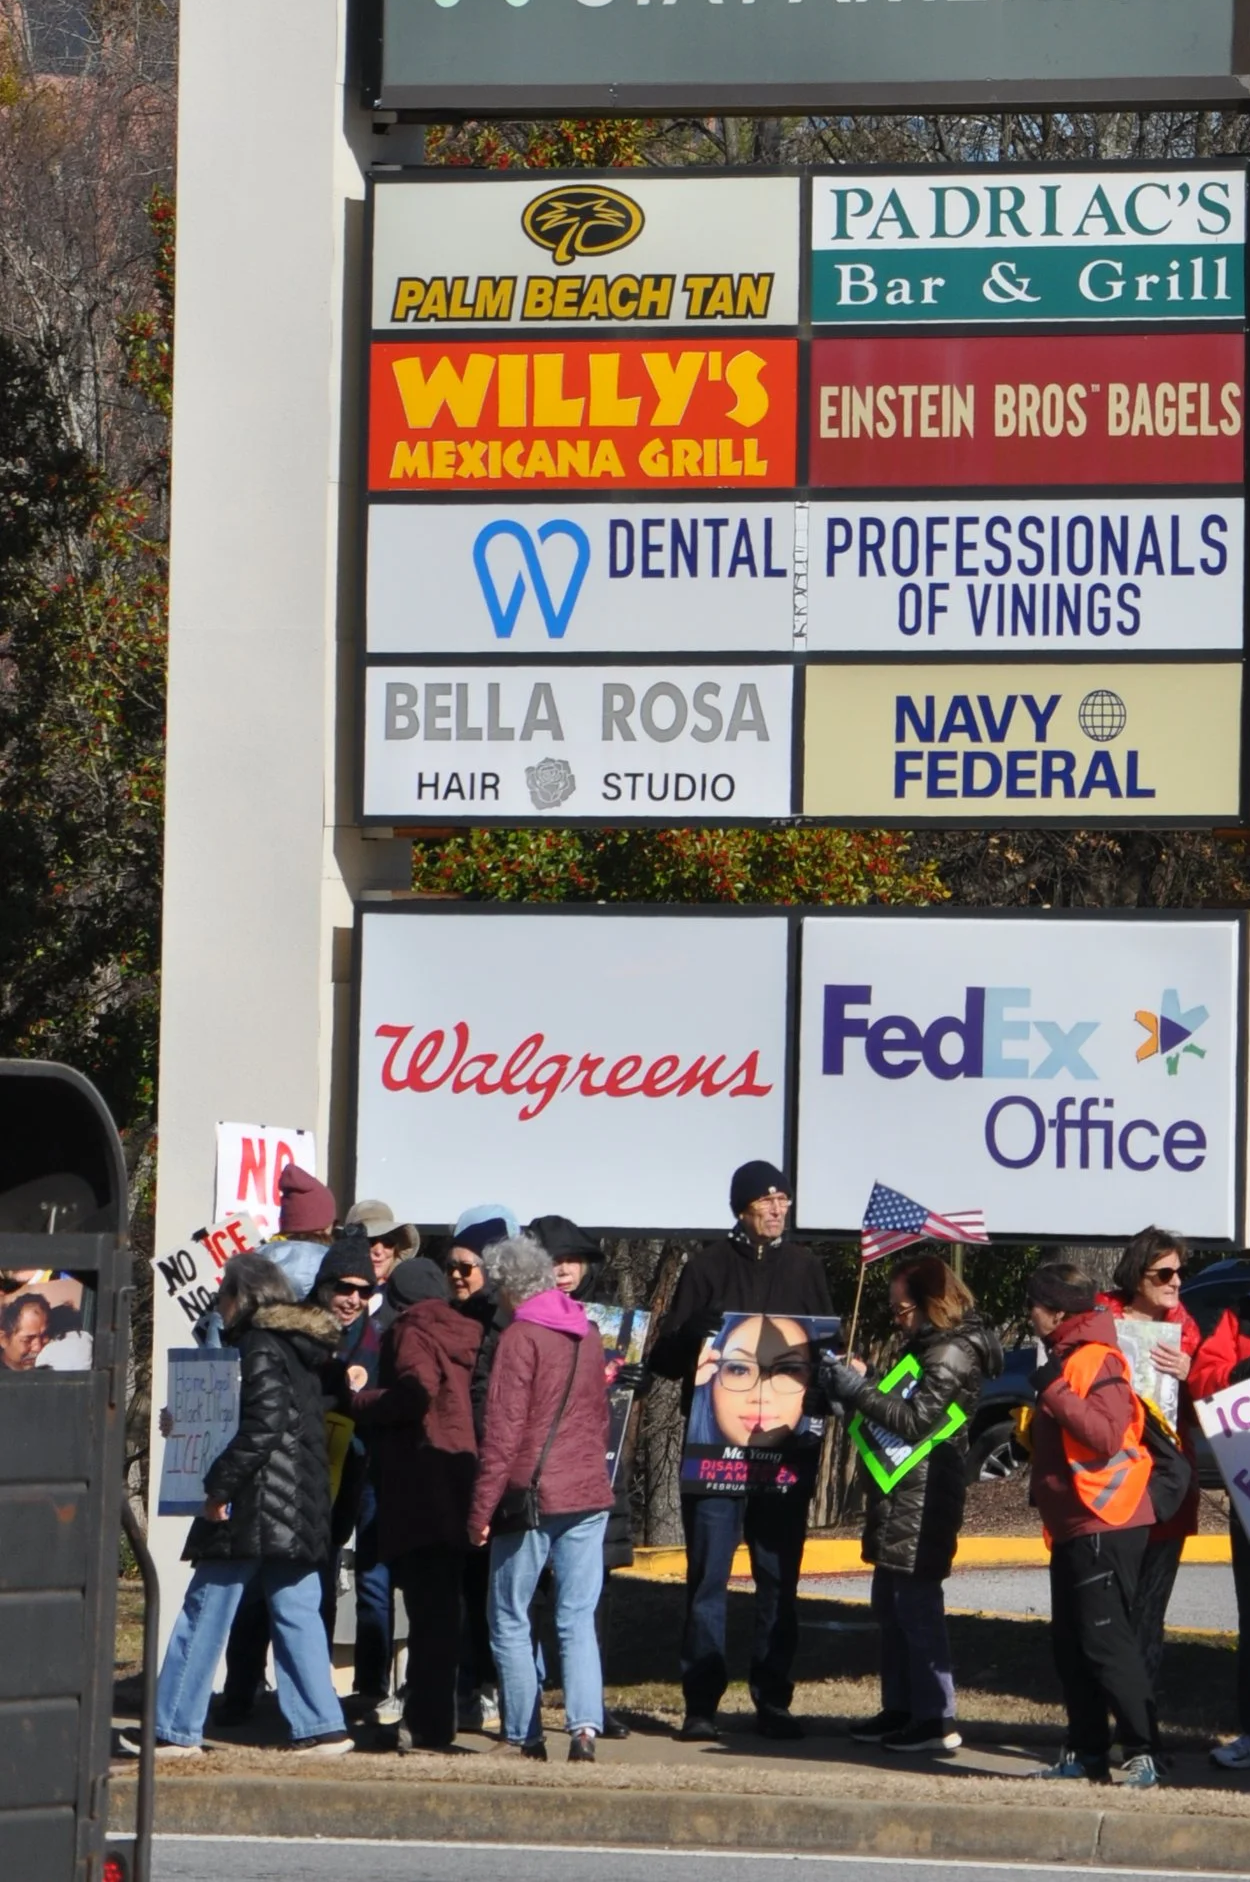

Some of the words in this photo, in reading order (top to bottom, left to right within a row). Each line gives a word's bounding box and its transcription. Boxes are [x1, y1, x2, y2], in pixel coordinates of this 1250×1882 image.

[830, 181, 1232, 240] PADRIAC'S
[391, 275, 518, 322] PALM
[520, 274, 677, 322] BEACH
[682, 272, 775, 320] TAN
[834, 263, 946, 305] Bar
[982, 261, 1041, 303] &
[1078, 256, 1231, 302] Grill
[391, 349, 770, 429] WILLY'S
[819, 384, 975, 439] EINSTEIN
[994, 383, 1087, 437] BROS
[1108, 382, 1242, 437] BAGELS
[389, 439, 626, 479] MEXICANA
[638, 437, 769, 478] GRILL
[609, 517, 788, 579] DENTAL
[826, 514, 1228, 578] PROFESSIONALS
[898, 582, 950, 636] OF
[967, 582, 1141, 637] VININGS
[384, 681, 565, 742] BELLA
[601, 681, 770, 744] ROSA
[895, 694, 1062, 743] NAVY
[417, 772, 500, 801] HAIR
[602, 772, 736, 802] STUDIO
[894, 749, 1156, 799] FEDERAL
[821, 984, 1101, 1081] FedEx
[375, 1021, 773, 1121] Walgreens
[984, 1095, 1207, 1172] Office
[157, 1249, 197, 1297] NO
[201, 1220, 254, 1269] ICE
